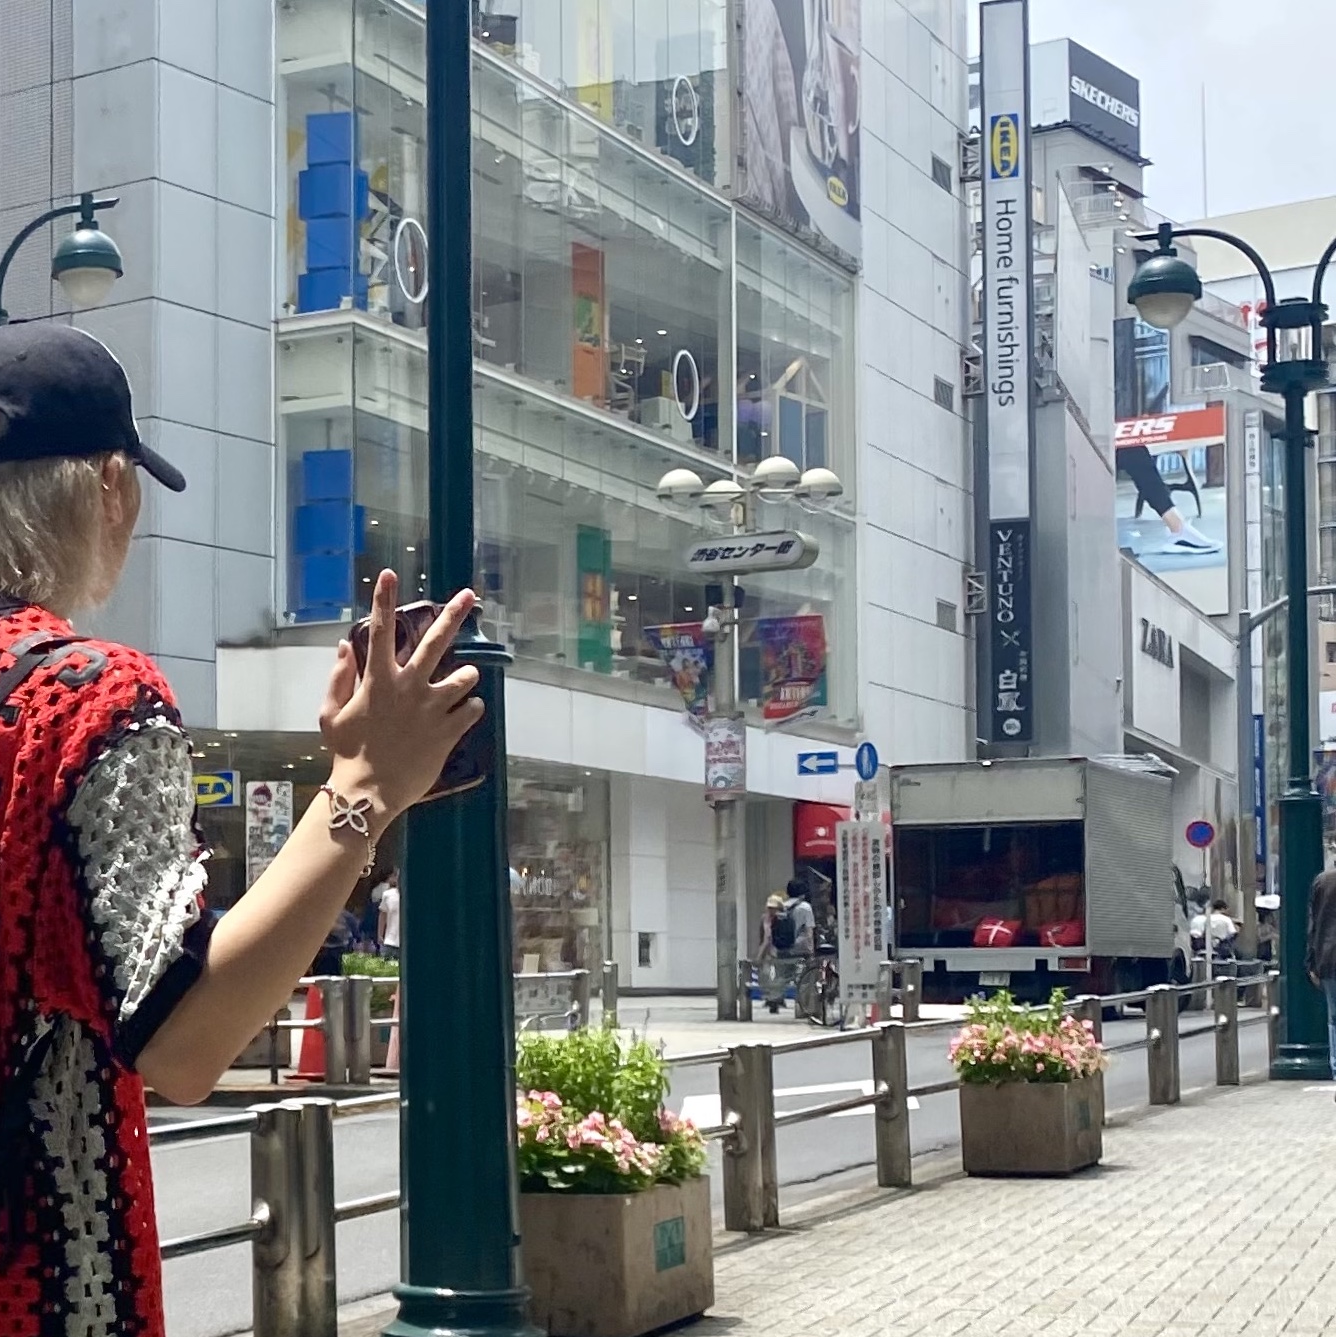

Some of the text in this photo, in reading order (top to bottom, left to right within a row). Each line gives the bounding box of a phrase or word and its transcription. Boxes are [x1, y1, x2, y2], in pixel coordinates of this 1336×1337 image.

[1070, 75, 1139, 127] SKECHERS
[999, 121, 1011, 173] IKEA
[990, 198, 1020, 408] Home furnishings
[1115, 415, 1178, 438] ERS
[997, 529, 1014, 622] VENTUNO
[1141, 617, 1175, 669] ZARA
